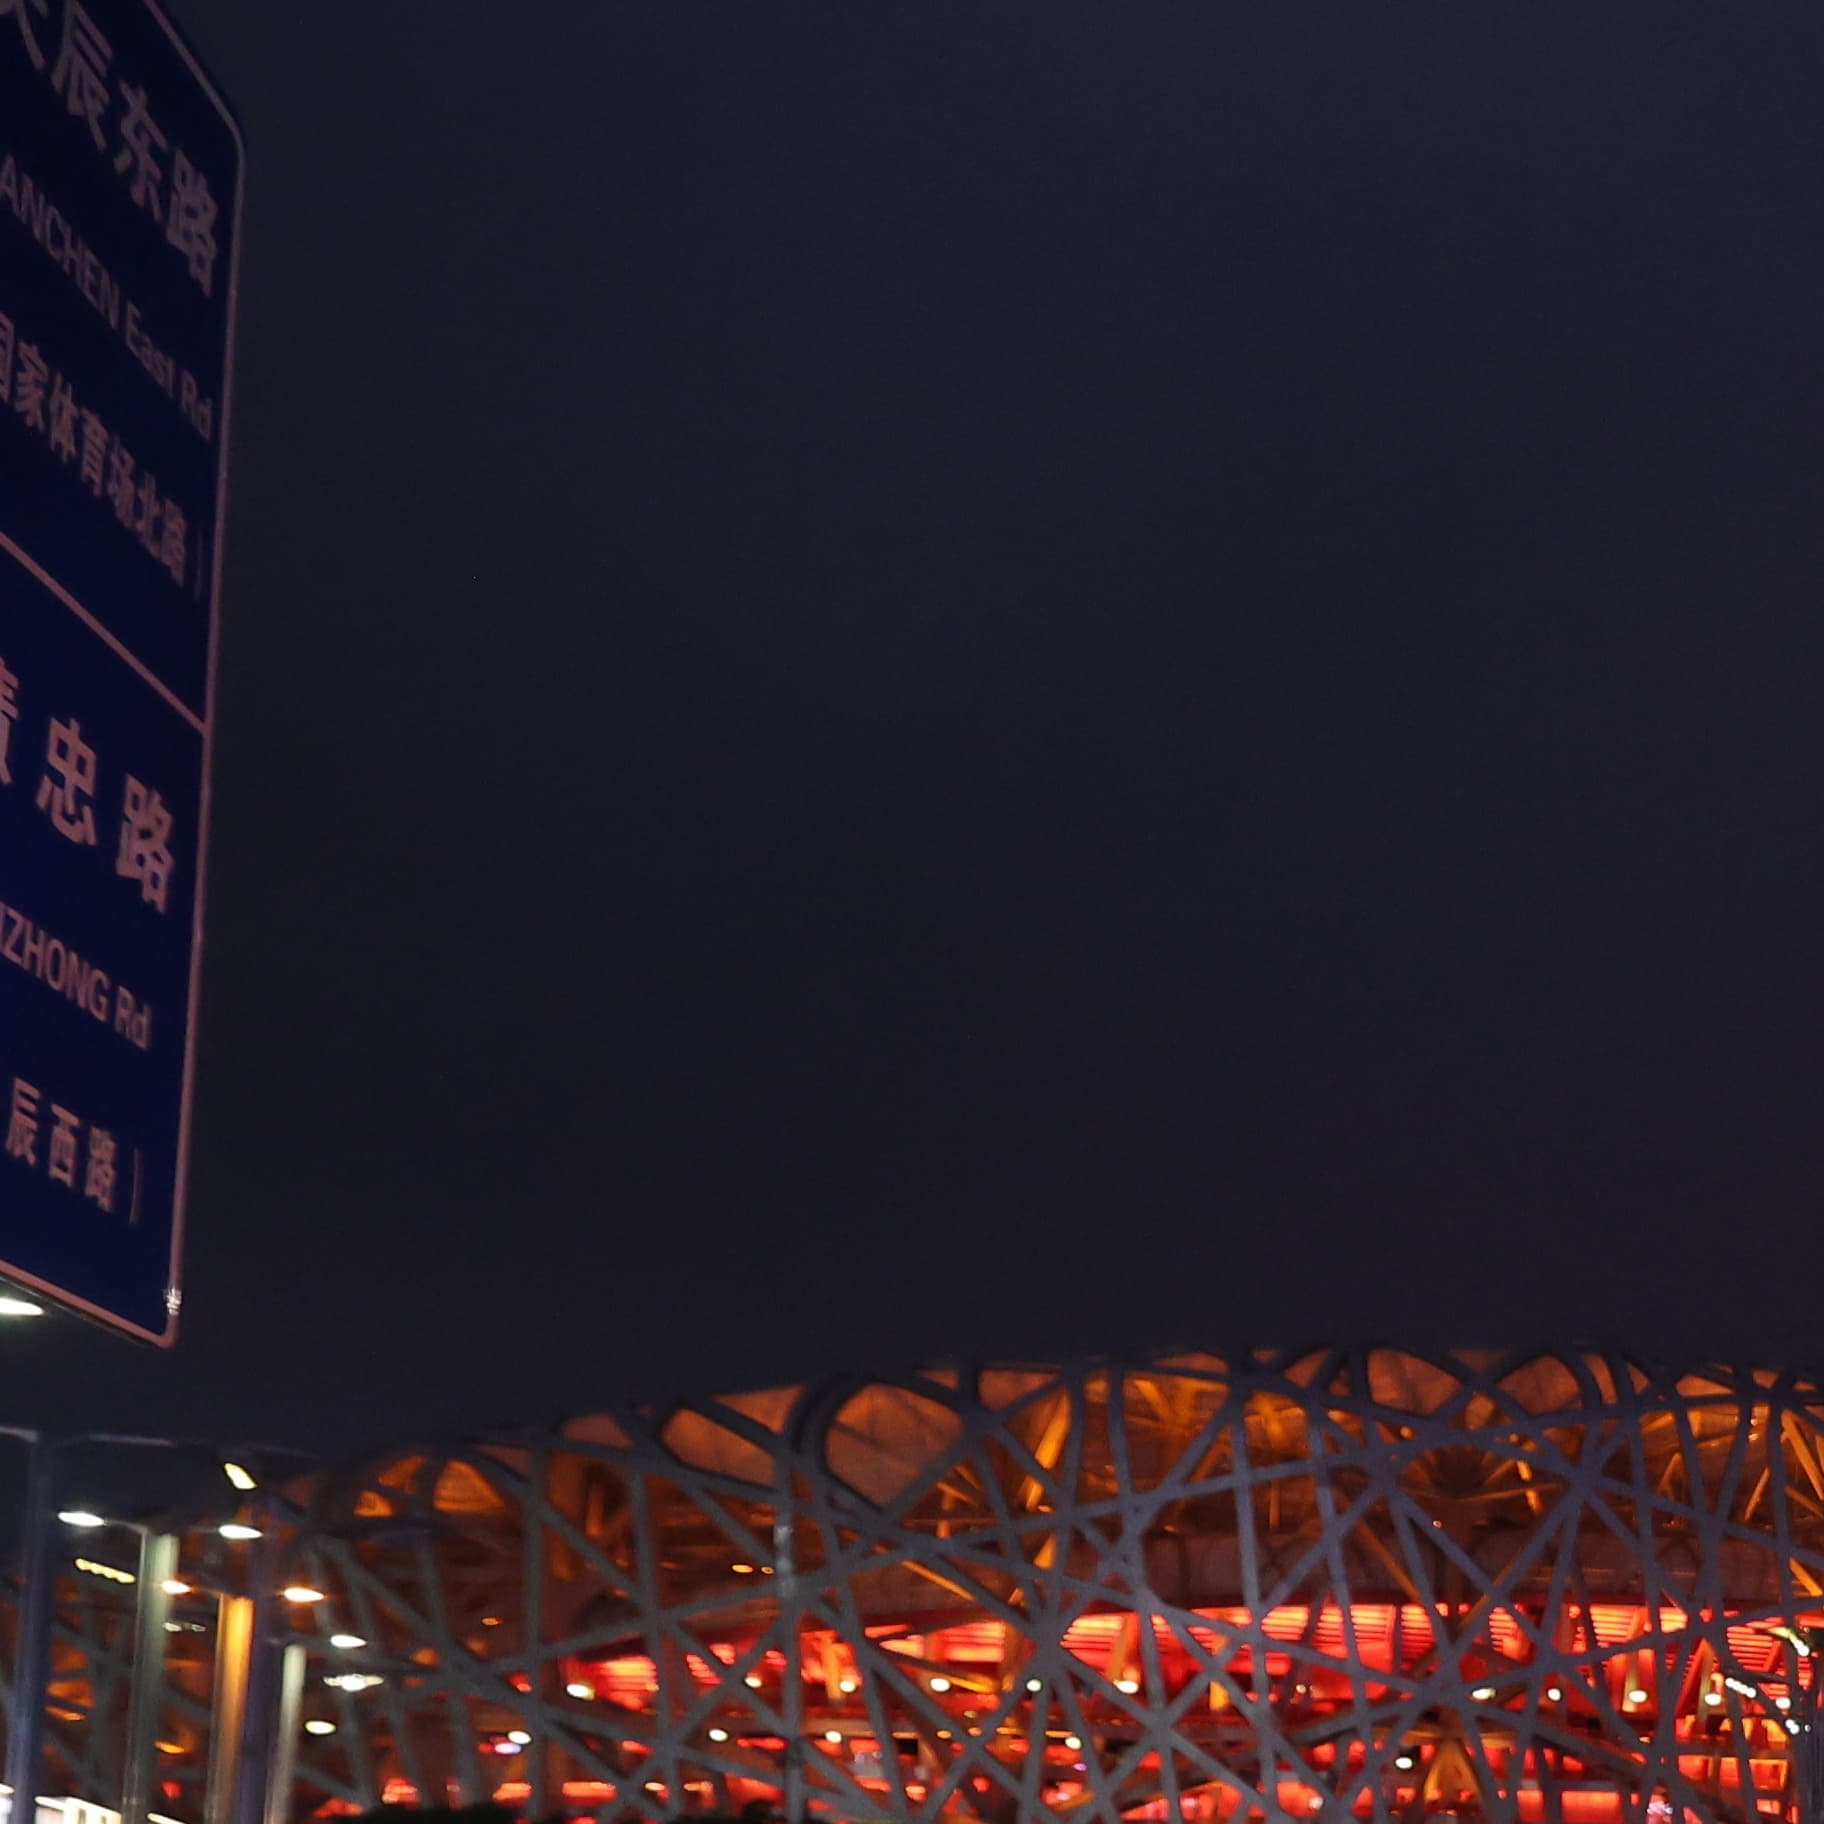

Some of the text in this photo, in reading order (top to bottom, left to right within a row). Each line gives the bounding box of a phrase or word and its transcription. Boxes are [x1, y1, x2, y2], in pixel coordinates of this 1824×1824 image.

[125, 300, 174, 399] East
[180, 369, 212, 442] Rd
[115, 985, 151, 1051] Rd
